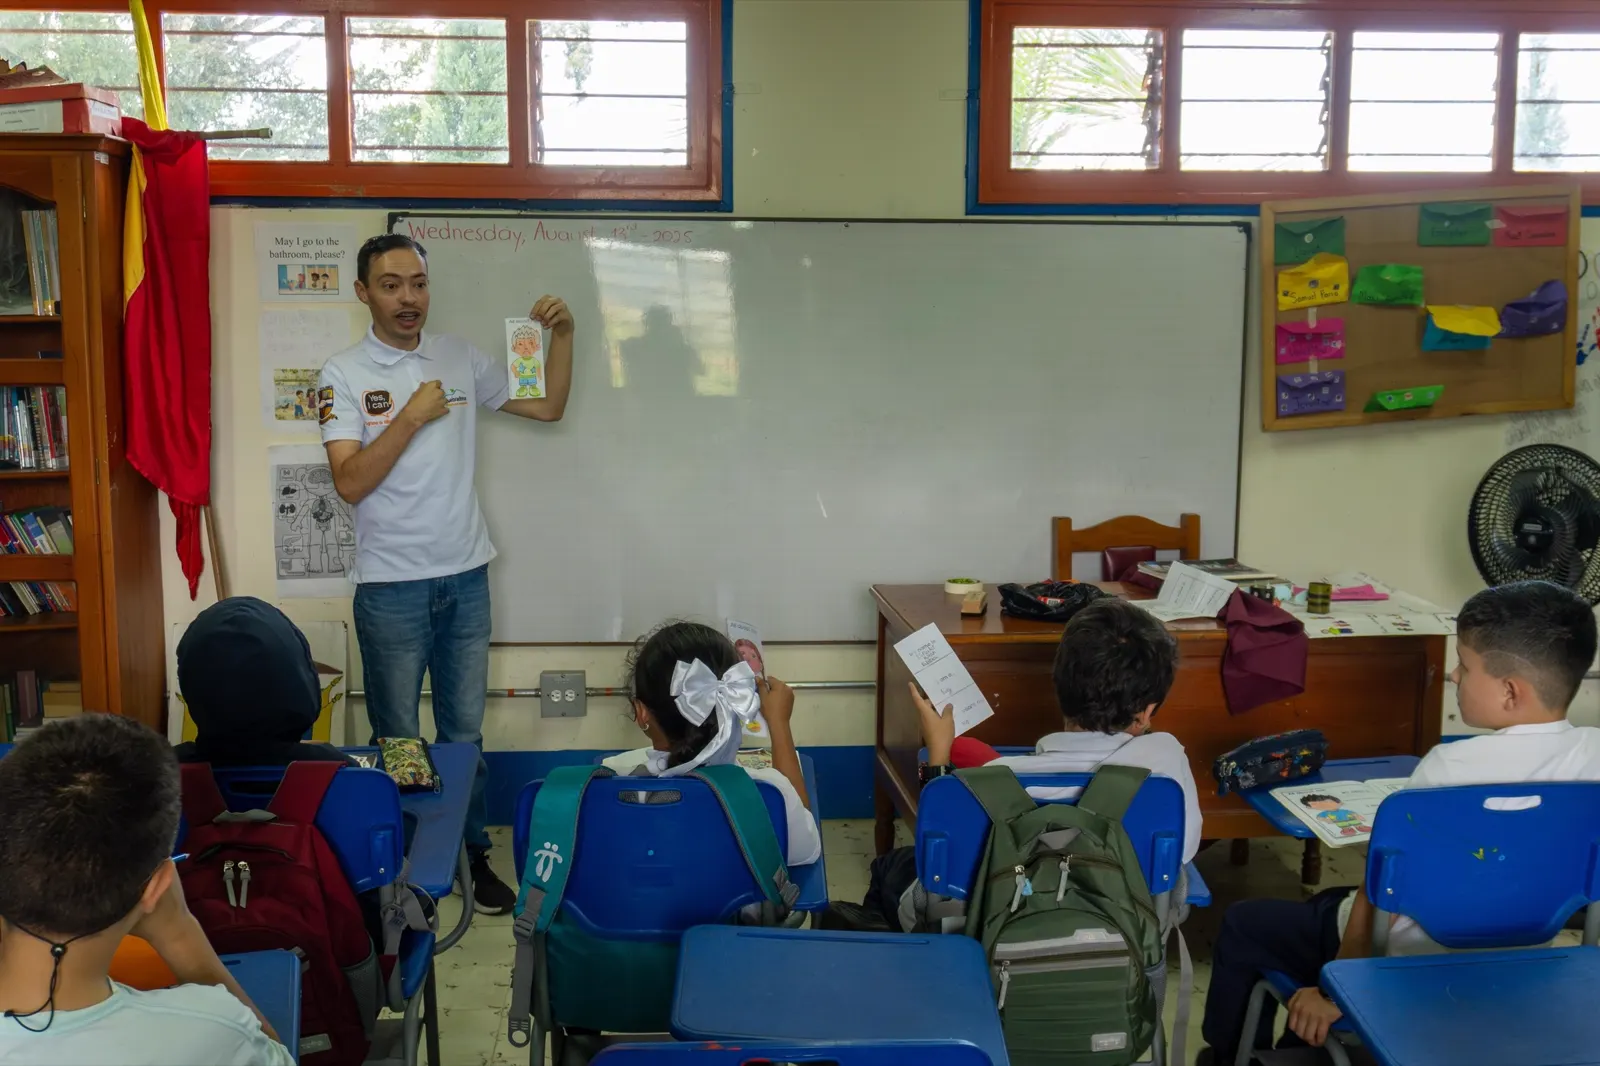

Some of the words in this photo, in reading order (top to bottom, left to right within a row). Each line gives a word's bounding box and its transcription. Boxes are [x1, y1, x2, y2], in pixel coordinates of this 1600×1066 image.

[407, 219, 526, 252] Wednesday,
[652, 229, 694, 243] 2025
[274, 237, 294, 247] May
[296, 237, 300, 246] I
[302, 239, 314, 248] go
[315, 238, 324, 246] to
[326, 237, 340, 246] the
[269, 250, 313, 260] bathroom,
[314, 250, 346, 260] please?
[368, 394, 386, 402] Yes,
[372, 401, 390, 409] can
